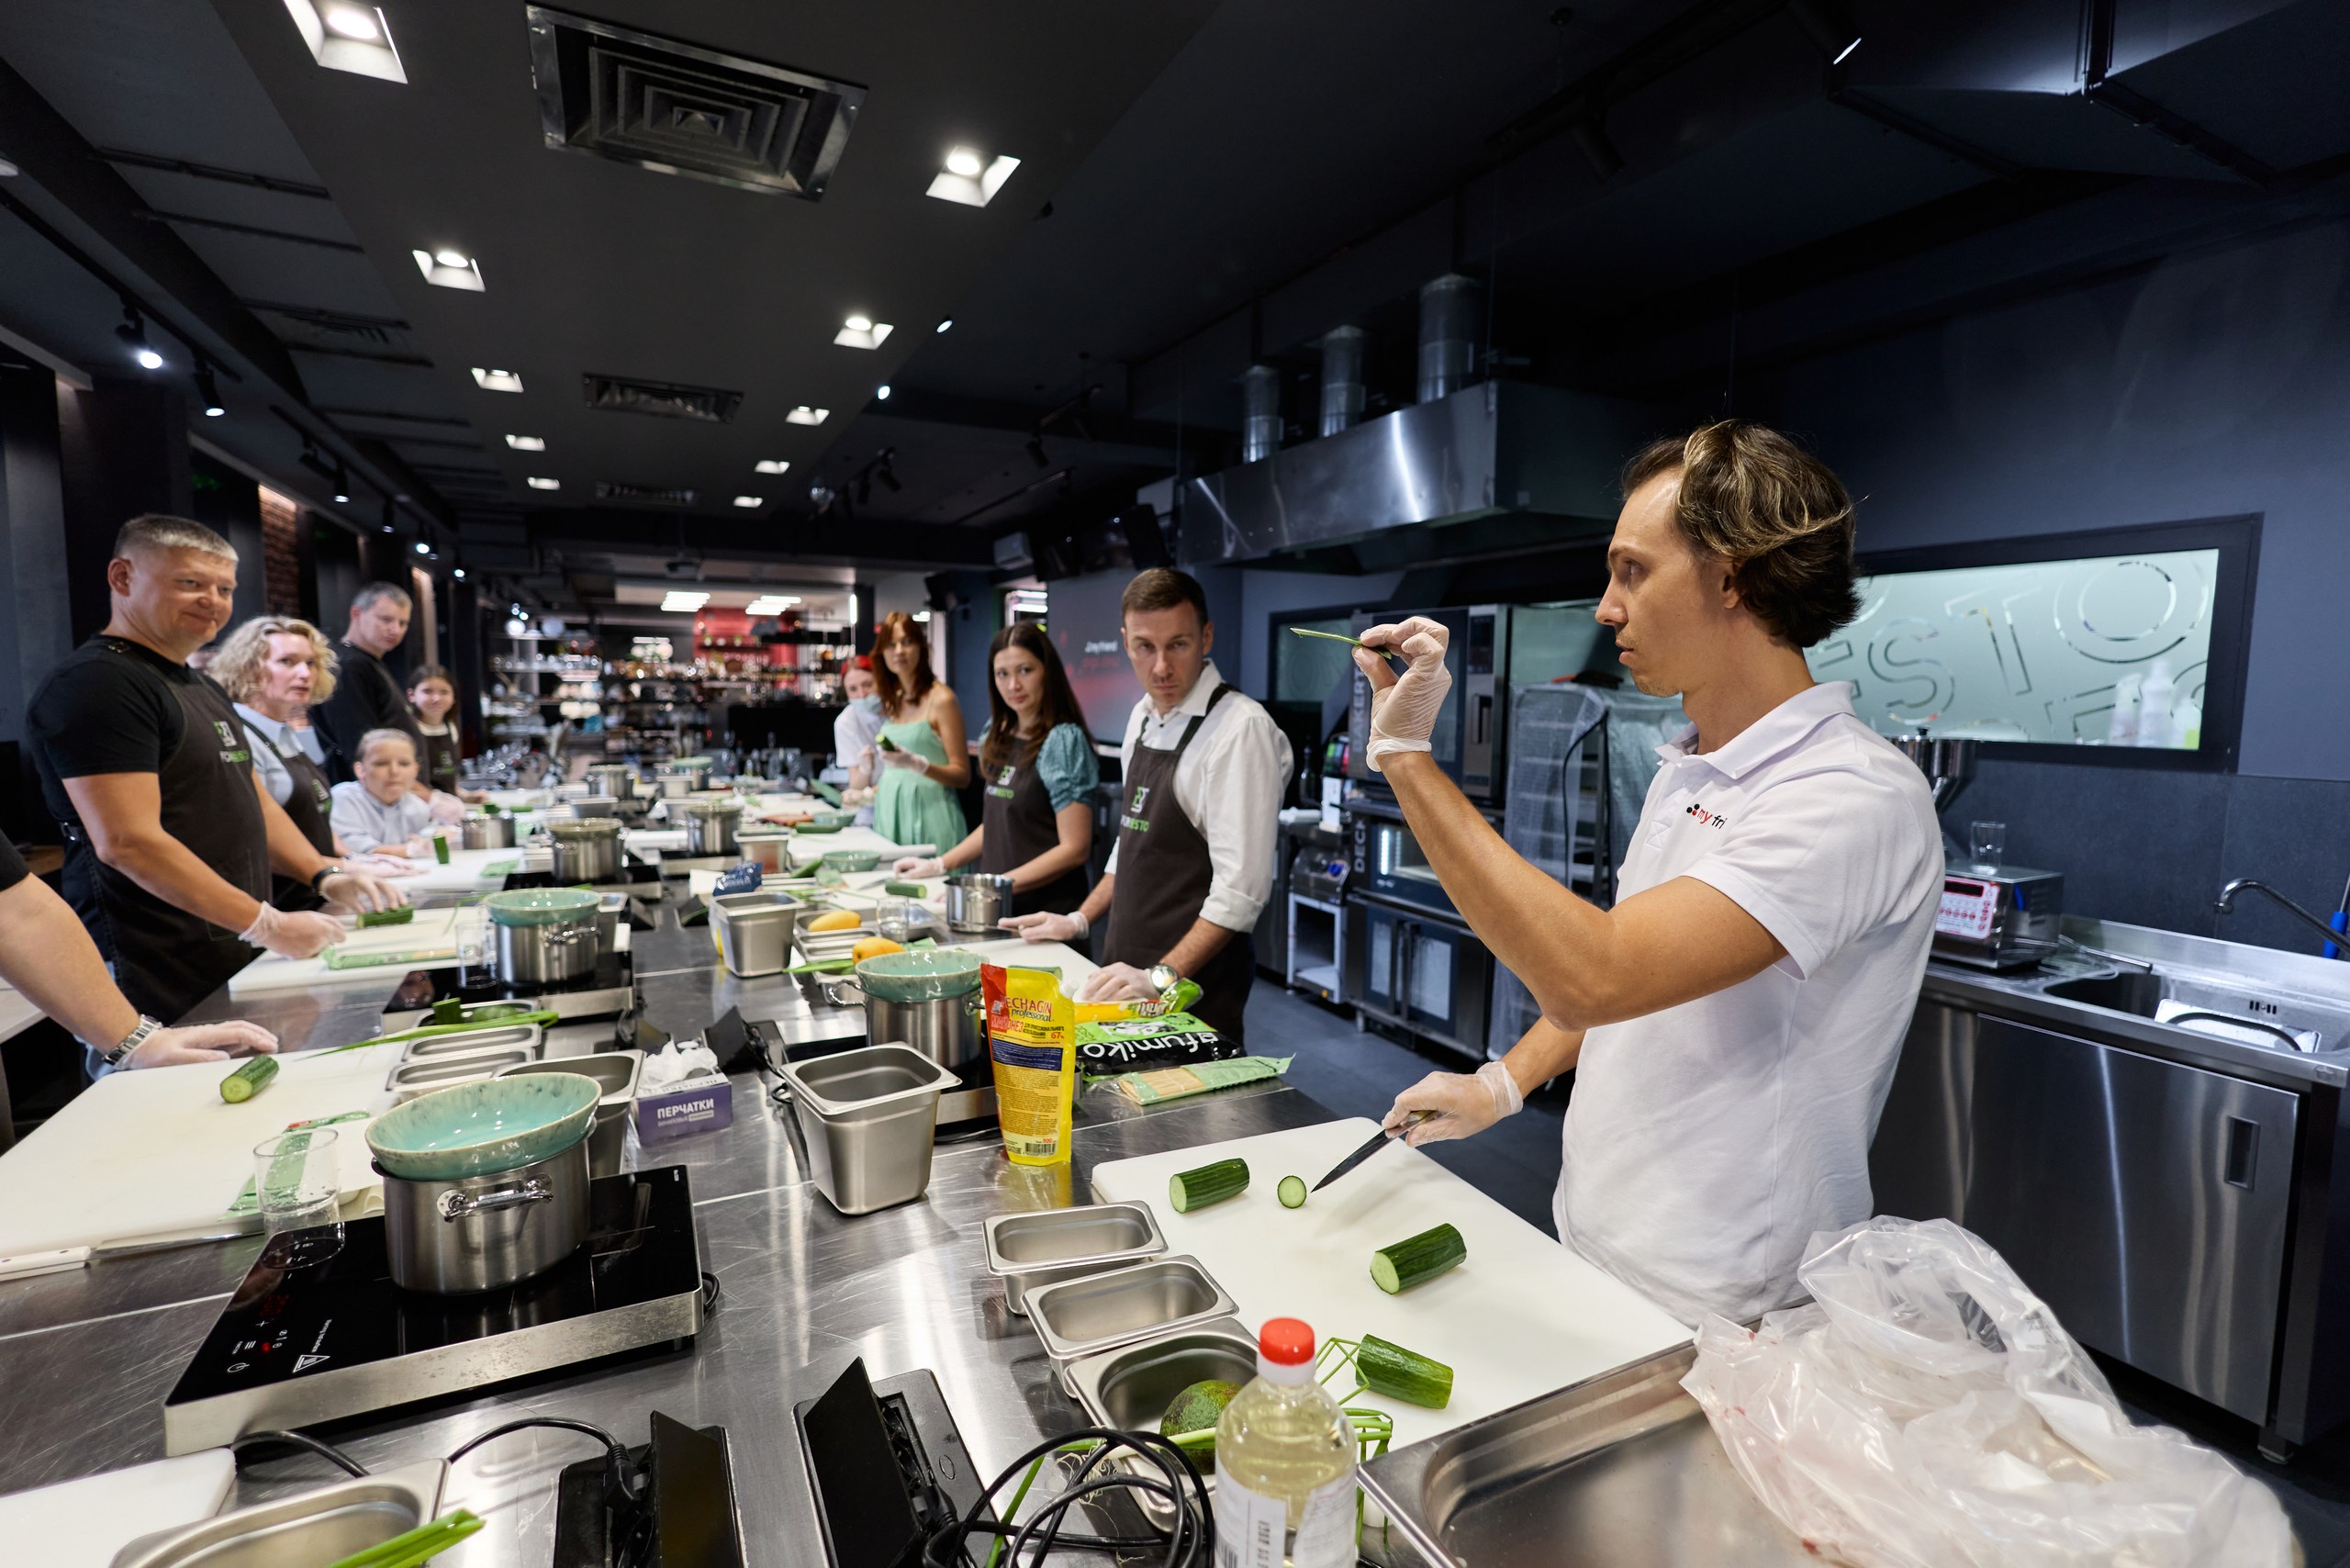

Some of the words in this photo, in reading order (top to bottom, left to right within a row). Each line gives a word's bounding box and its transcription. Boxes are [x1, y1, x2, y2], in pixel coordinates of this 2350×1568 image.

[1697, 809, 1713, 823] my
[1083, 1033, 1198, 1062] fumiko
[657, 1098, 714, 1119] ПЕРЧАТКИ
